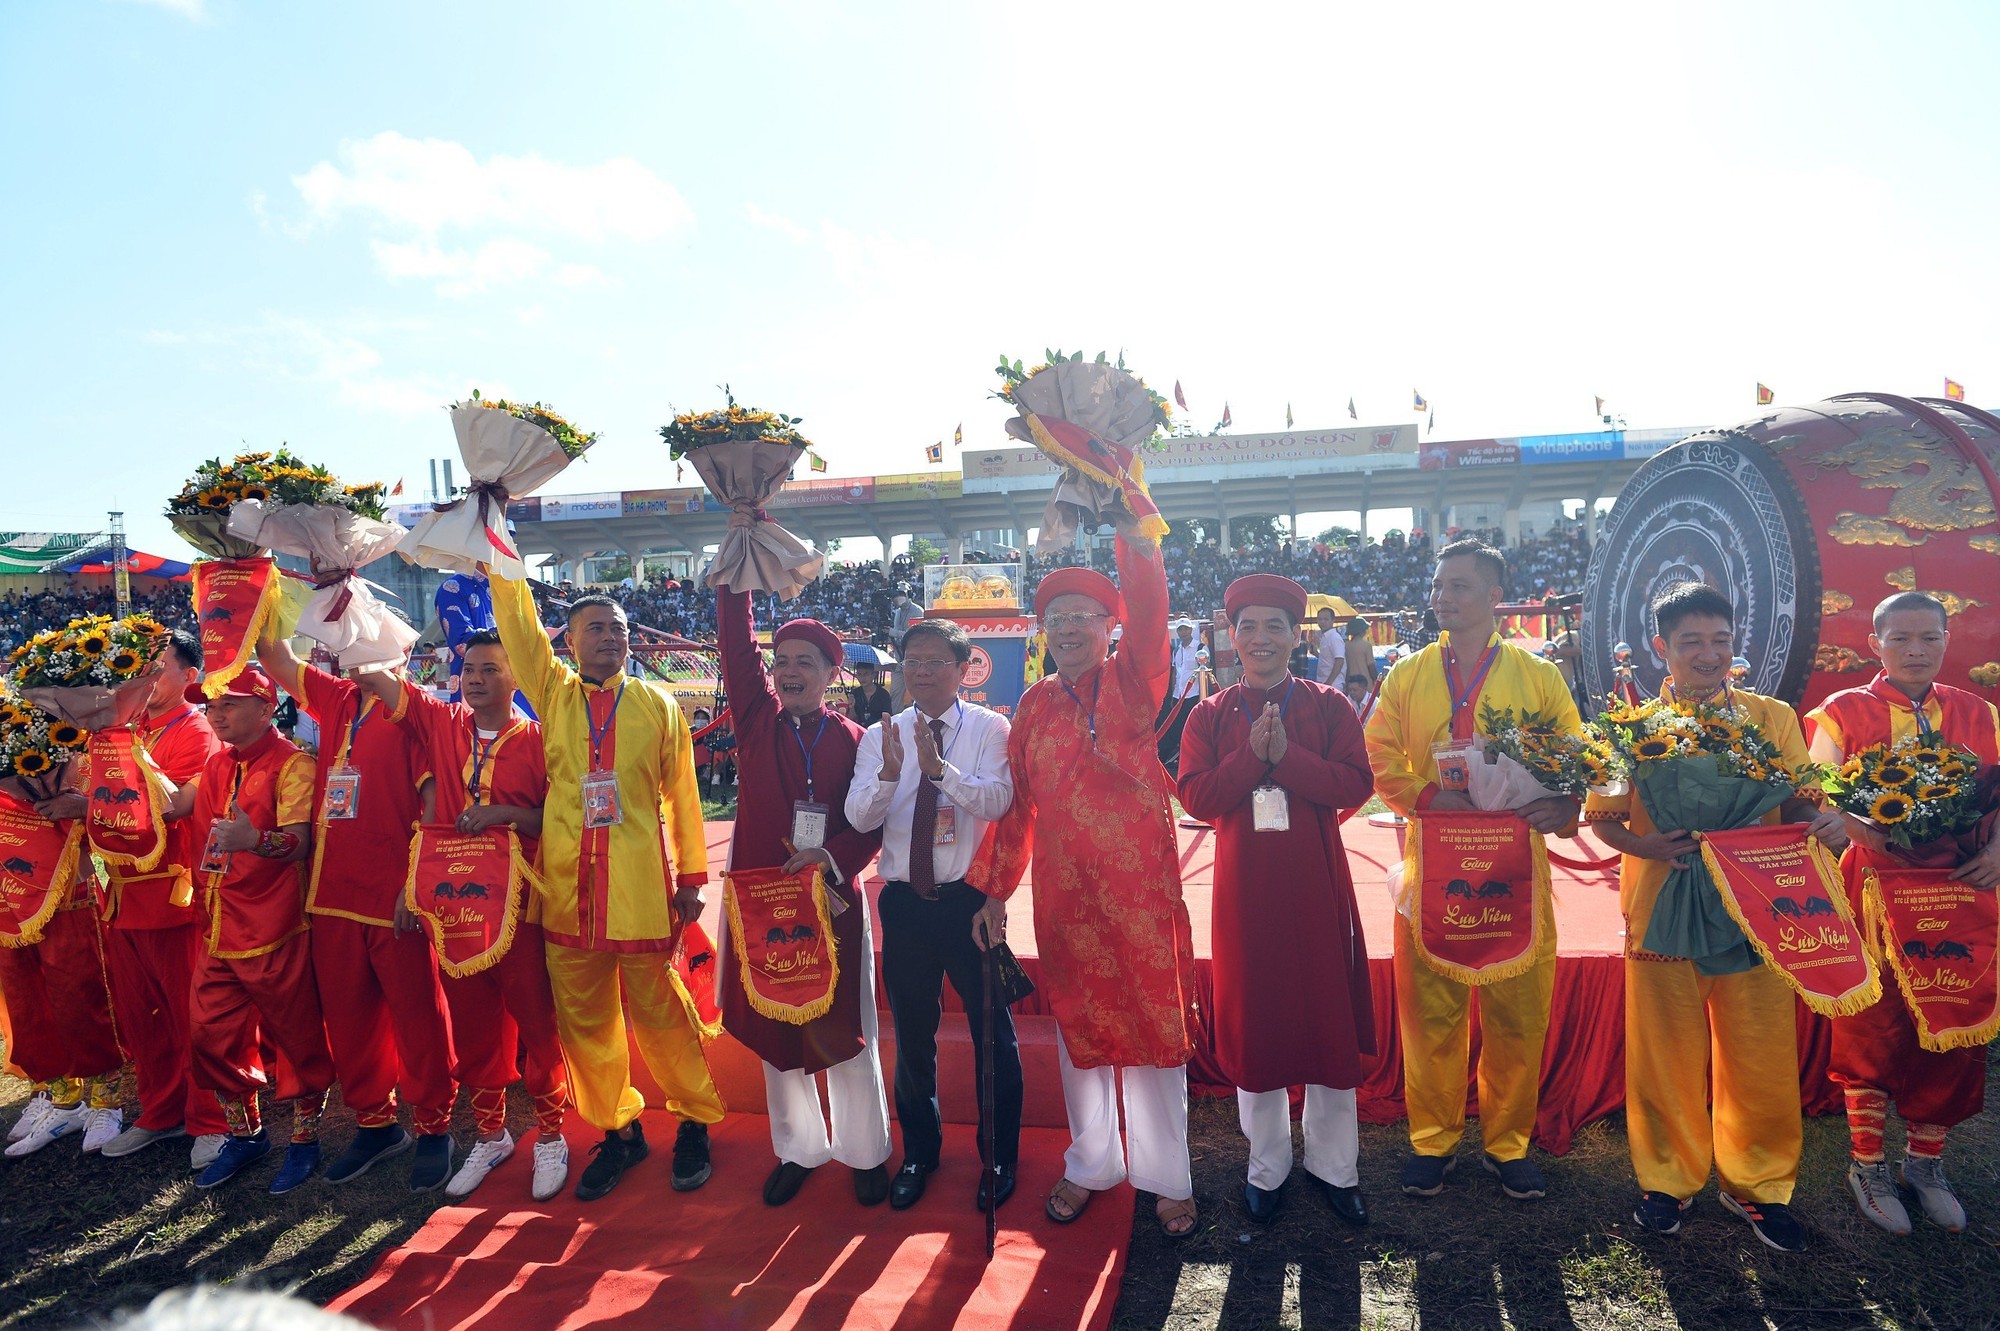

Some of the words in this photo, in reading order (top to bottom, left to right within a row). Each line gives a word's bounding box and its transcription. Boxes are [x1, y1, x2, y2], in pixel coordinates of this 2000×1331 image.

[1180, 437, 1250, 453] TRÂU
[1258, 431, 1297, 448] ĐỒ
[1303, 431, 1358, 446] SƠN
[1533, 439, 1613, 455] vinaphone
[1467, 446, 1482, 456] Tốc
[1483, 446, 1494, 455] độ
[1494, 446, 1505, 454] tối
[1459, 455, 1482, 466] Wifi
[571, 500, 617, 511] mobifone
[772, 496, 797, 506] Dragon
[797, 494, 818, 503] Ocean
[673, 688, 696, 698] CÔNG
[447, 862, 476, 875] Tặng
[1460, 857, 1493, 872] Tặng
[1758, 861, 1780, 870] NĂM
[1780, 859, 1803, 868] 2023
[1, 876, 27, 898] Niệm
[1773, 873, 1806, 888] Tặng
[764, 895, 781, 903] NĂM
[772, 906, 798, 920] Tặng
[1910, 904, 1932, 912] NĂM
[1933, 903, 1958, 911] 2023
[457, 906, 485, 925] Niệm
[1442, 904, 1477, 928] Lưu
[1477, 906, 1513, 927] Niệm
[1916, 917, 1950, 932] Tặng
[1777, 926, 1817, 953] Lưu
[1817, 926, 1851, 949] Niệm
[764, 951, 791, 973] Lưu
[791, 950, 819, 968] Niệm
[1929, 967, 1971, 989] Niệm
